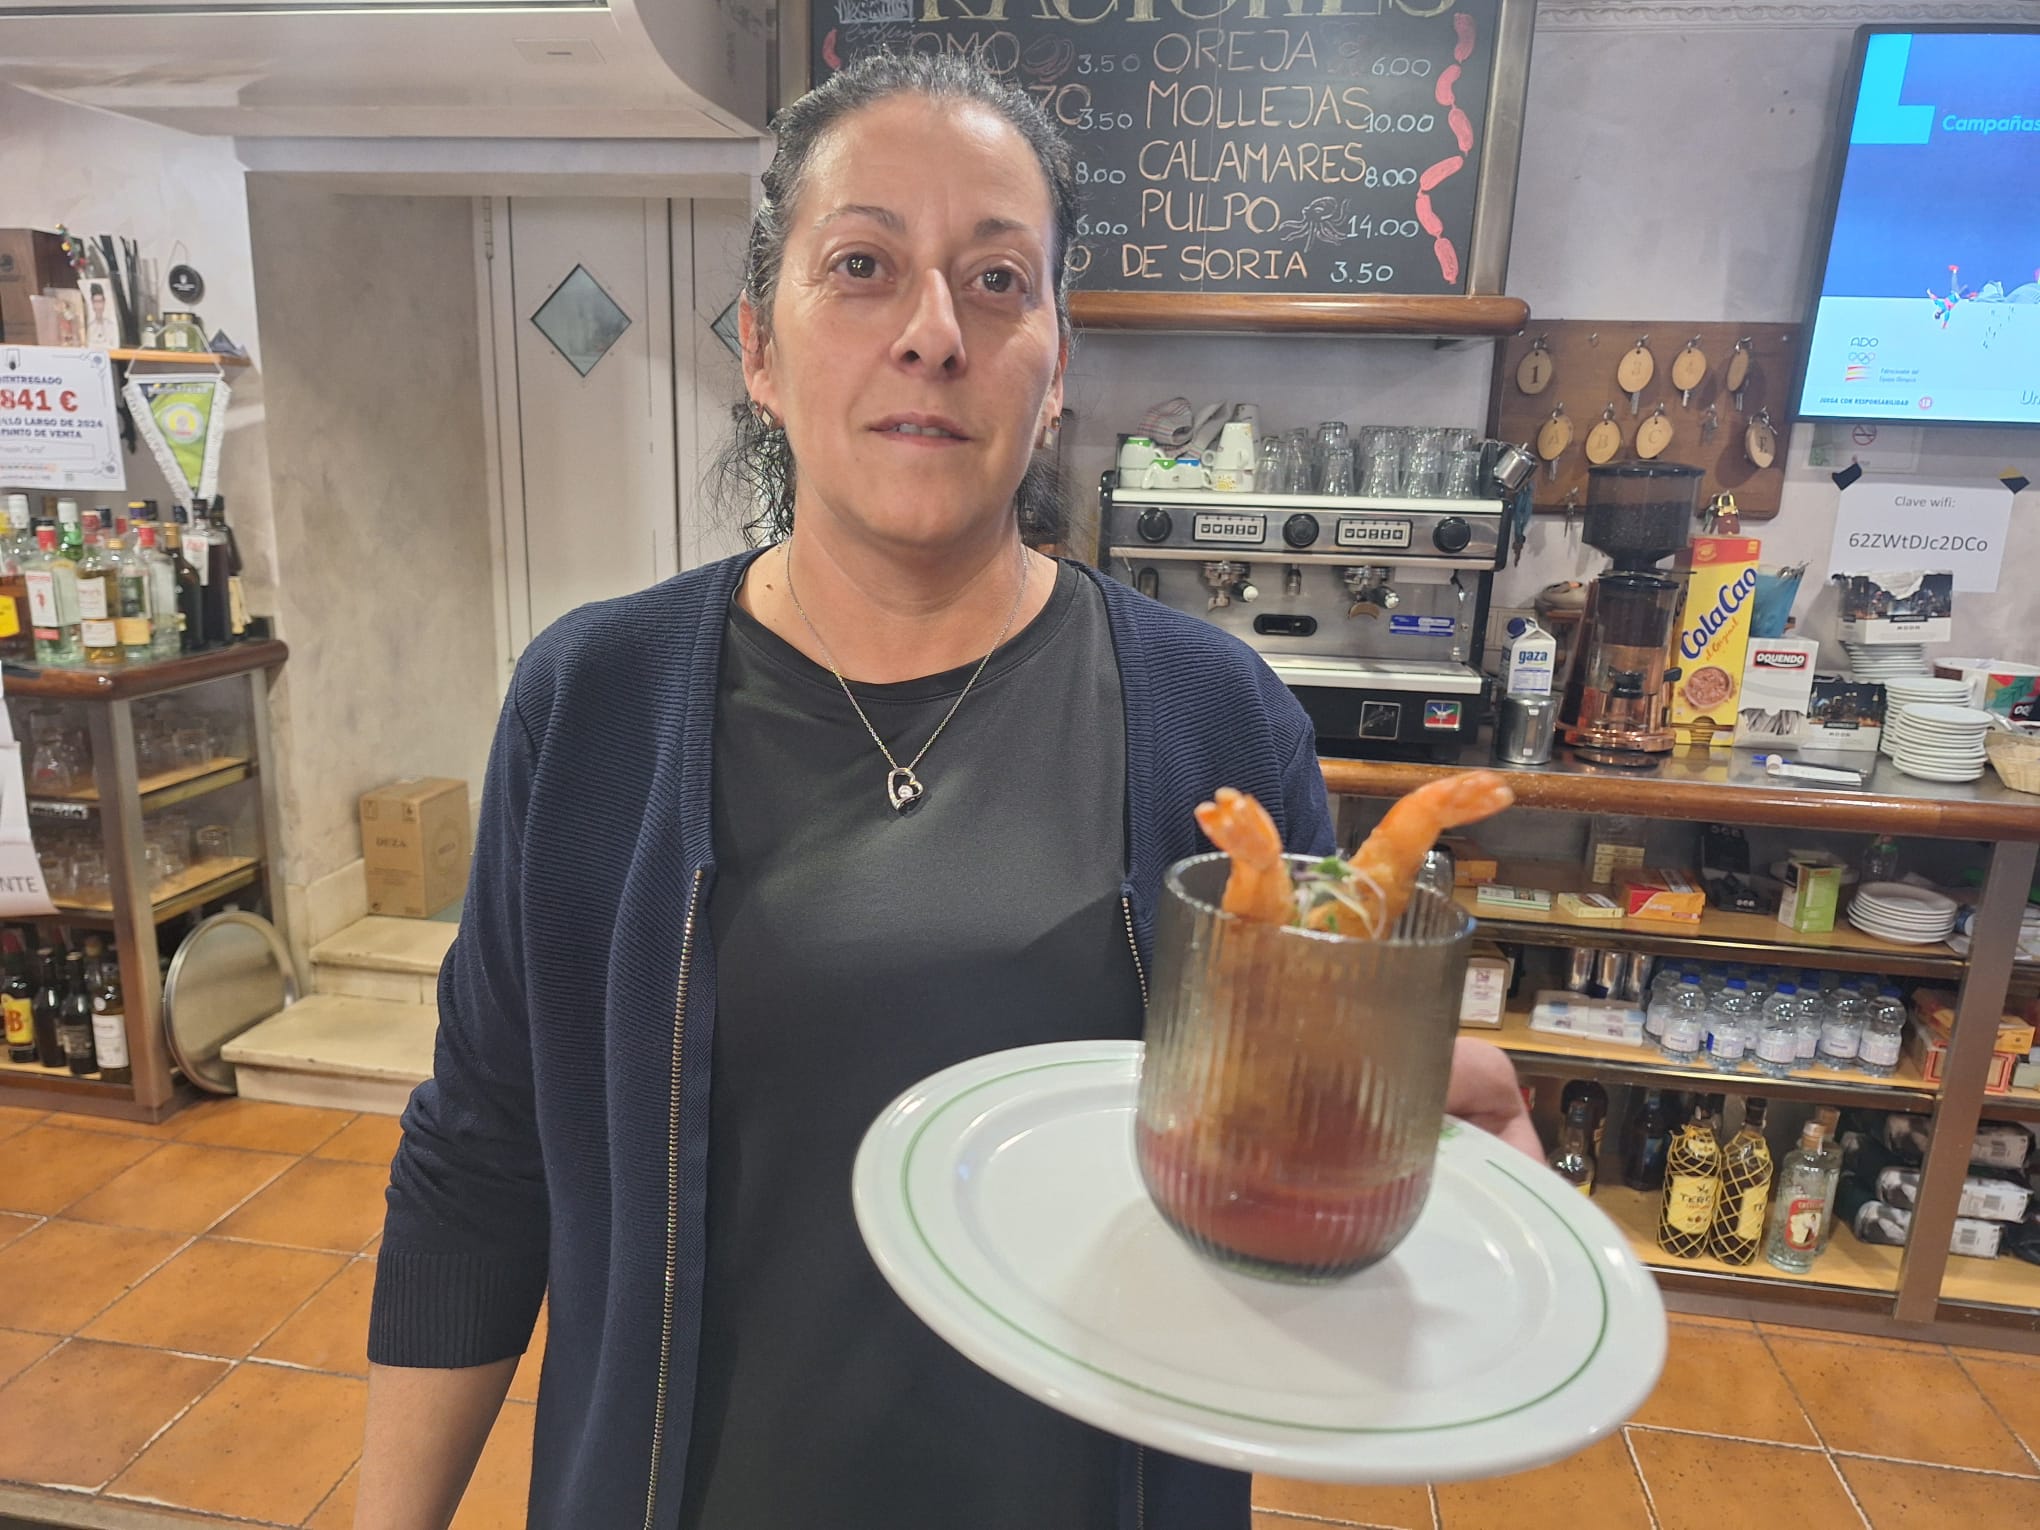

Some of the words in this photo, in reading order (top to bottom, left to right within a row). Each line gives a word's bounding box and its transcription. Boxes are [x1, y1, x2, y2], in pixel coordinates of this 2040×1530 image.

[909, 31, 1020, 75] OMO
[1153, 28, 1318, 74] OREJA
[1371, 56, 1431, 77] 6.00
[1076, 109, 1133, 130] 3.50
[1146, 81, 1373, 129] MOLLEJAS
[1364, 111, 1434, 133] 10.00
[1138, 138, 1368, 184] CALAMARES
[1364, 166, 1417, 188] 8.00
[1141, 188, 1282, 234] PULPO
[1347, 214, 1419, 239] 14.00
[1122, 243, 1168, 279] DE
[1180, 245, 1308, 282] SORIA
[1330, 261, 1394, 284] 3.50
[59, 389, 79, 413] €
[1895, 496, 1927, 507] Clave
[1930, 496, 1956, 508] wifi:
[1849, 532, 1988, 552] 62ZWtDJc2DCo
[1680, 567, 1758, 660] ColaCao
[1518, 650, 1549, 664] gaza
[1756, 652, 1805, 667] OQUENDO
[0, 876, 40, 894] NTE
